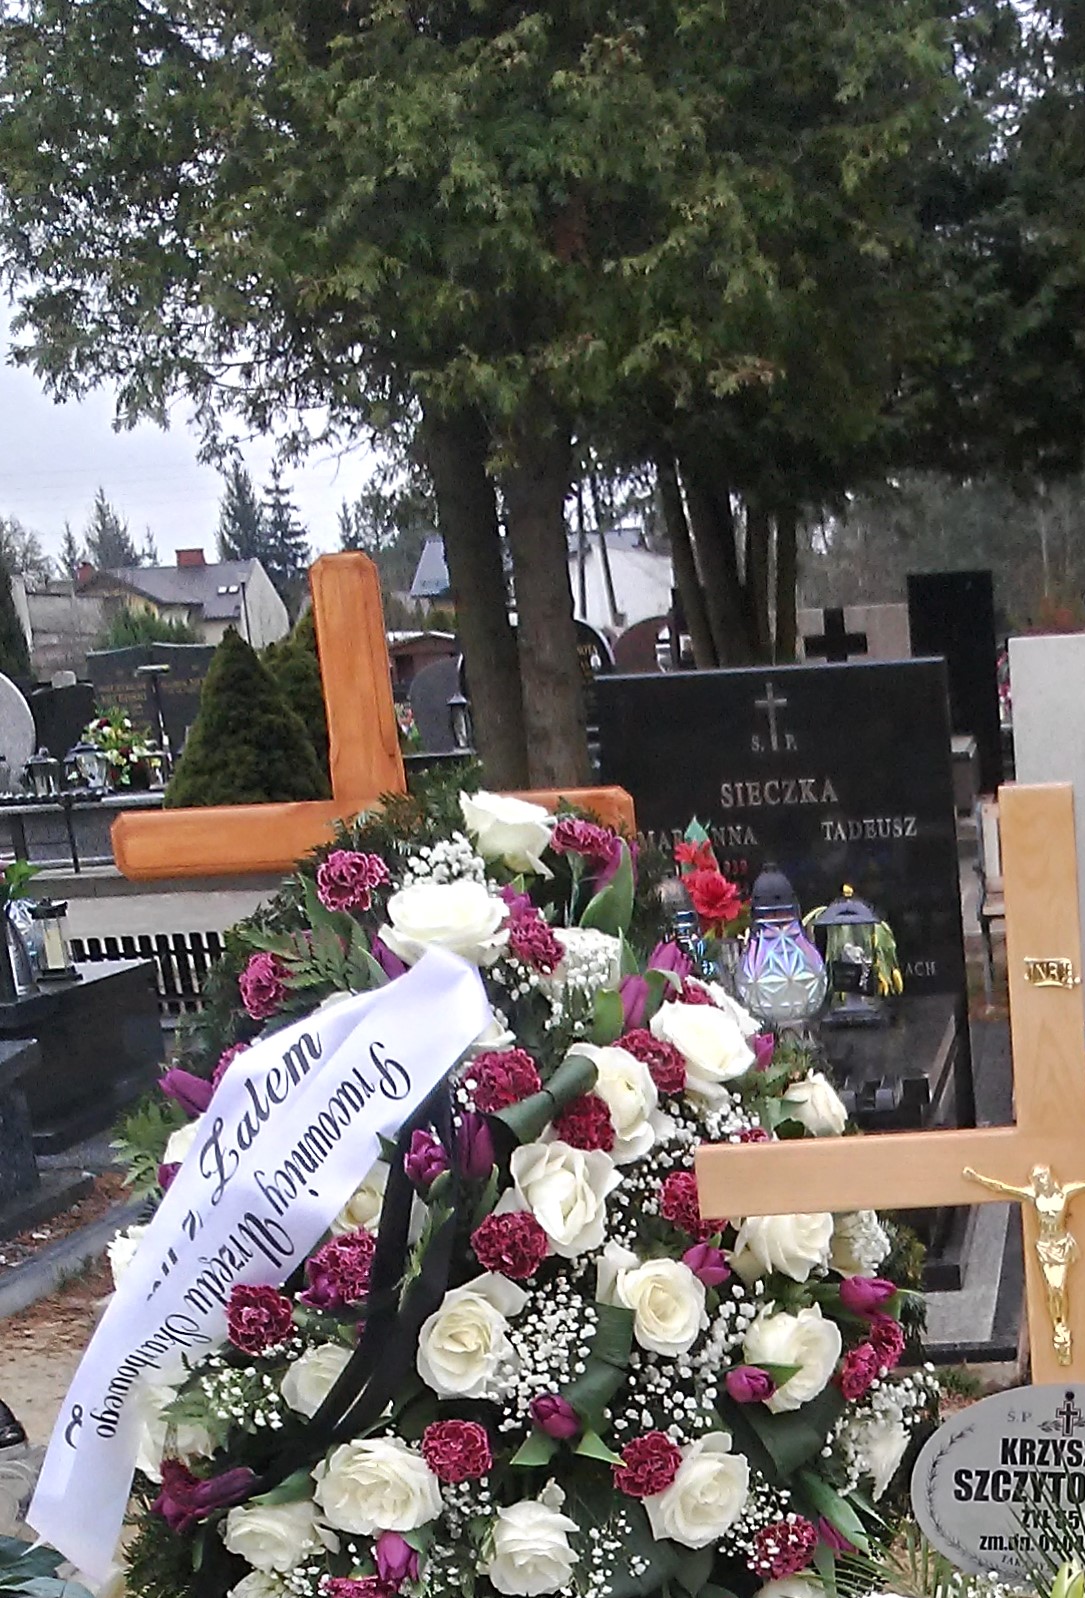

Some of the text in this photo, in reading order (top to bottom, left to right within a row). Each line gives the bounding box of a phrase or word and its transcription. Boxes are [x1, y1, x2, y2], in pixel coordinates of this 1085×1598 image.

[720, 777, 839, 808] SIECZKA
[637, 816, 918, 853] MARNNA TADEUSZ
[254, 1041, 411, 1216] Pracownicy
[184, 1212, 294, 1315] Urzędu
